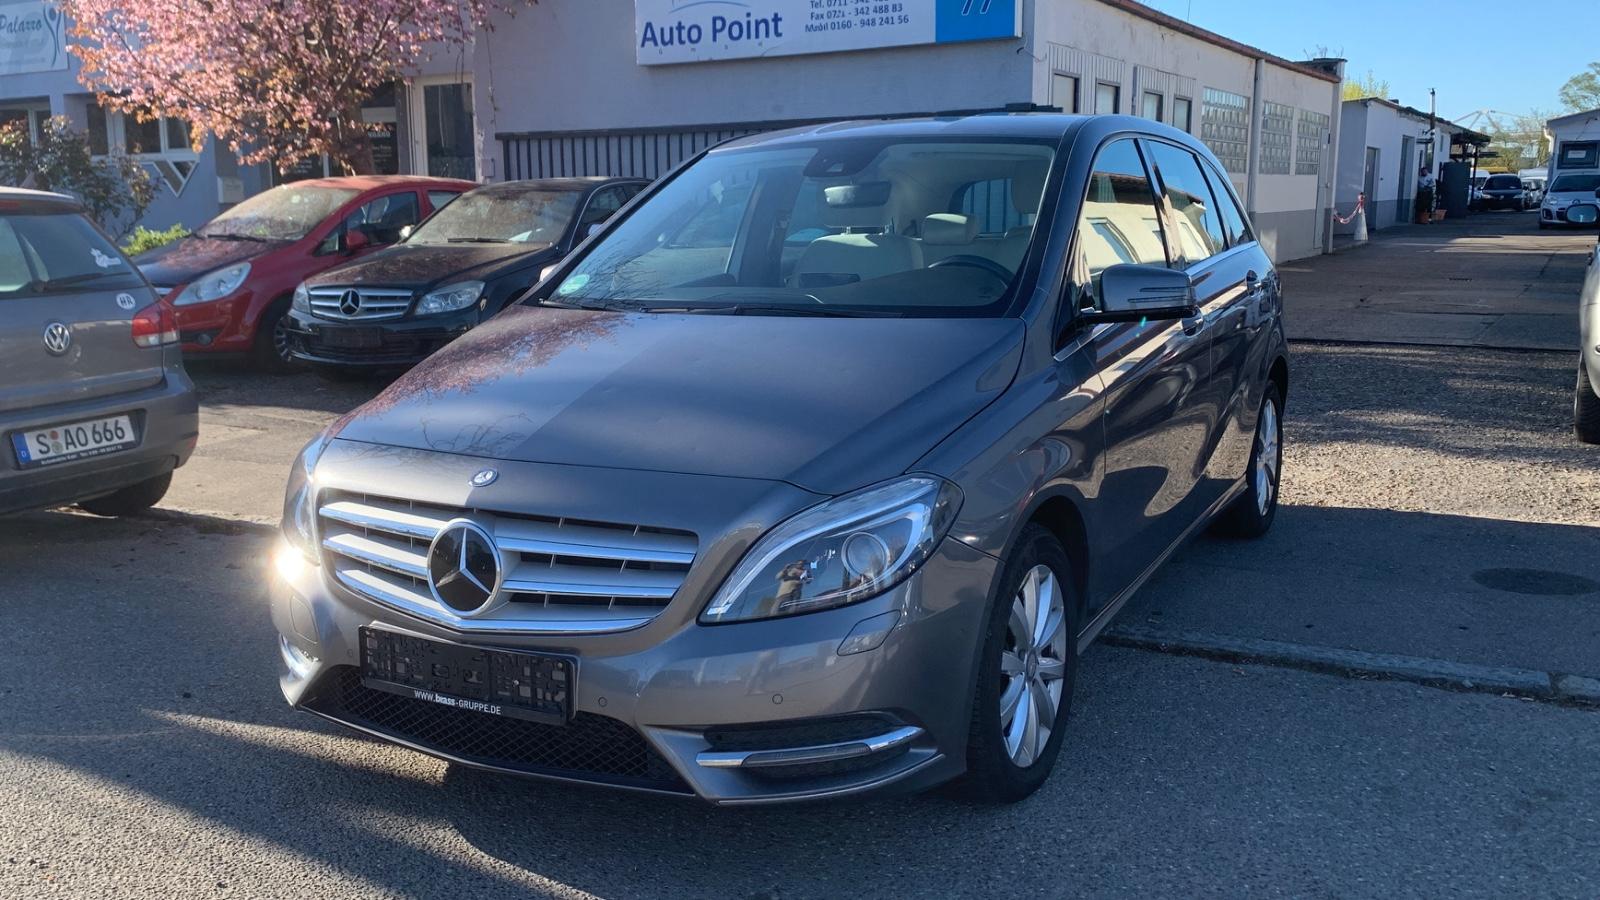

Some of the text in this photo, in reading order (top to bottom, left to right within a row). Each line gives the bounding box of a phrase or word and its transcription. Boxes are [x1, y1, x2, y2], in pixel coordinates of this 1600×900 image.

[805, 22, 829, 32] Mobil
[830, 20, 853, 30] 0160
[860, 17, 877, 28] 948
[878, 16, 896, 26] 241
[897, 14, 910, 24] 56
[810, 11, 825, 21] Fax
[854, 6, 871, 16] 342
[872, 4, 890, 14] 488
[891, 3, 903, 13] 83
[640, 12, 784, 48] Auto Point
[36, 433, 51, 455] S
[64, 427, 89, 450] AO
[92, 420, 125, 444] 666
